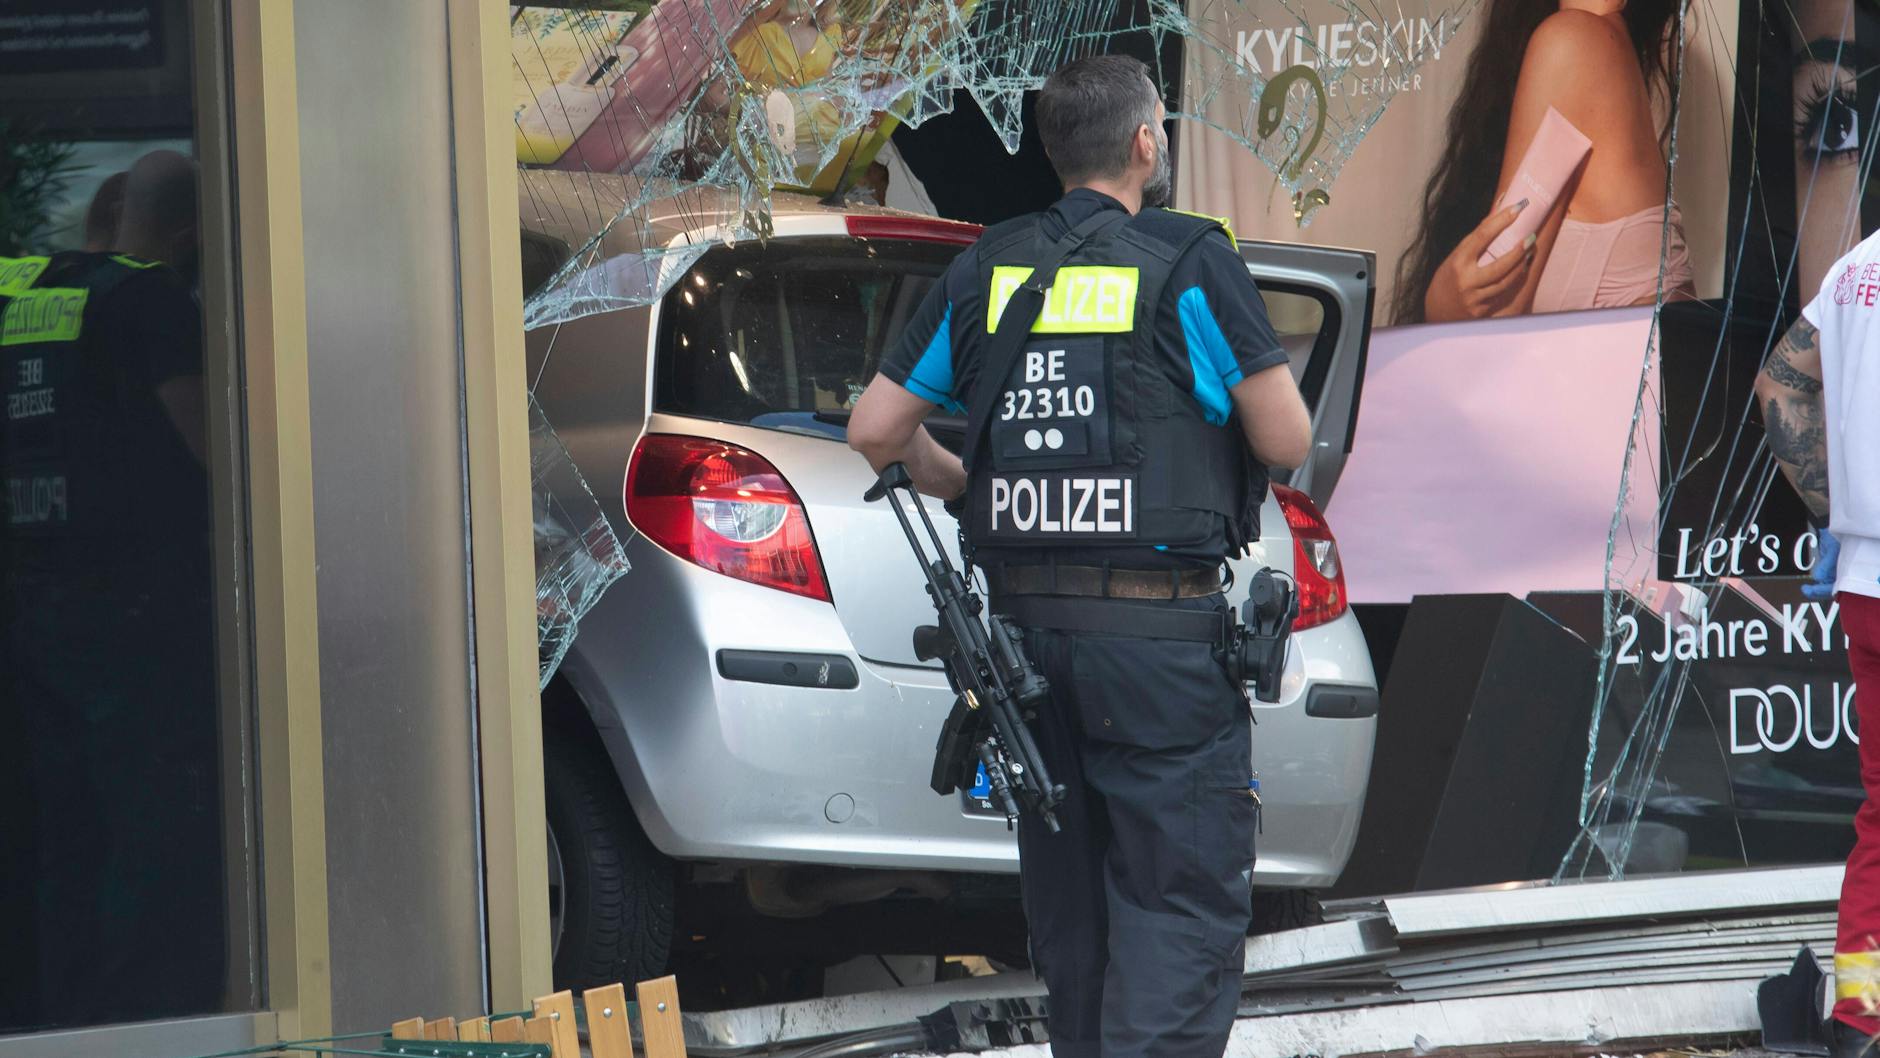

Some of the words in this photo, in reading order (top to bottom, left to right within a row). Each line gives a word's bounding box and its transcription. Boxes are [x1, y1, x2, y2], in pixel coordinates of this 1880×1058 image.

[1352, 74, 1421, 96] JENNER
[1861, 262, 1880, 281] BE
[997, 273, 1131, 324] PLIZEI
[1855, 283, 1880, 306] FE
[1025, 350, 1065, 383] BE
[1001, 385, 1095, 421] 32310
[991, 477, 1132, 532] POLIZEI
[1615, 614, 1640, 665] 2
[1651, 607, 1768, 663] Jahre
[1783, 601, 1849, 653] KY
